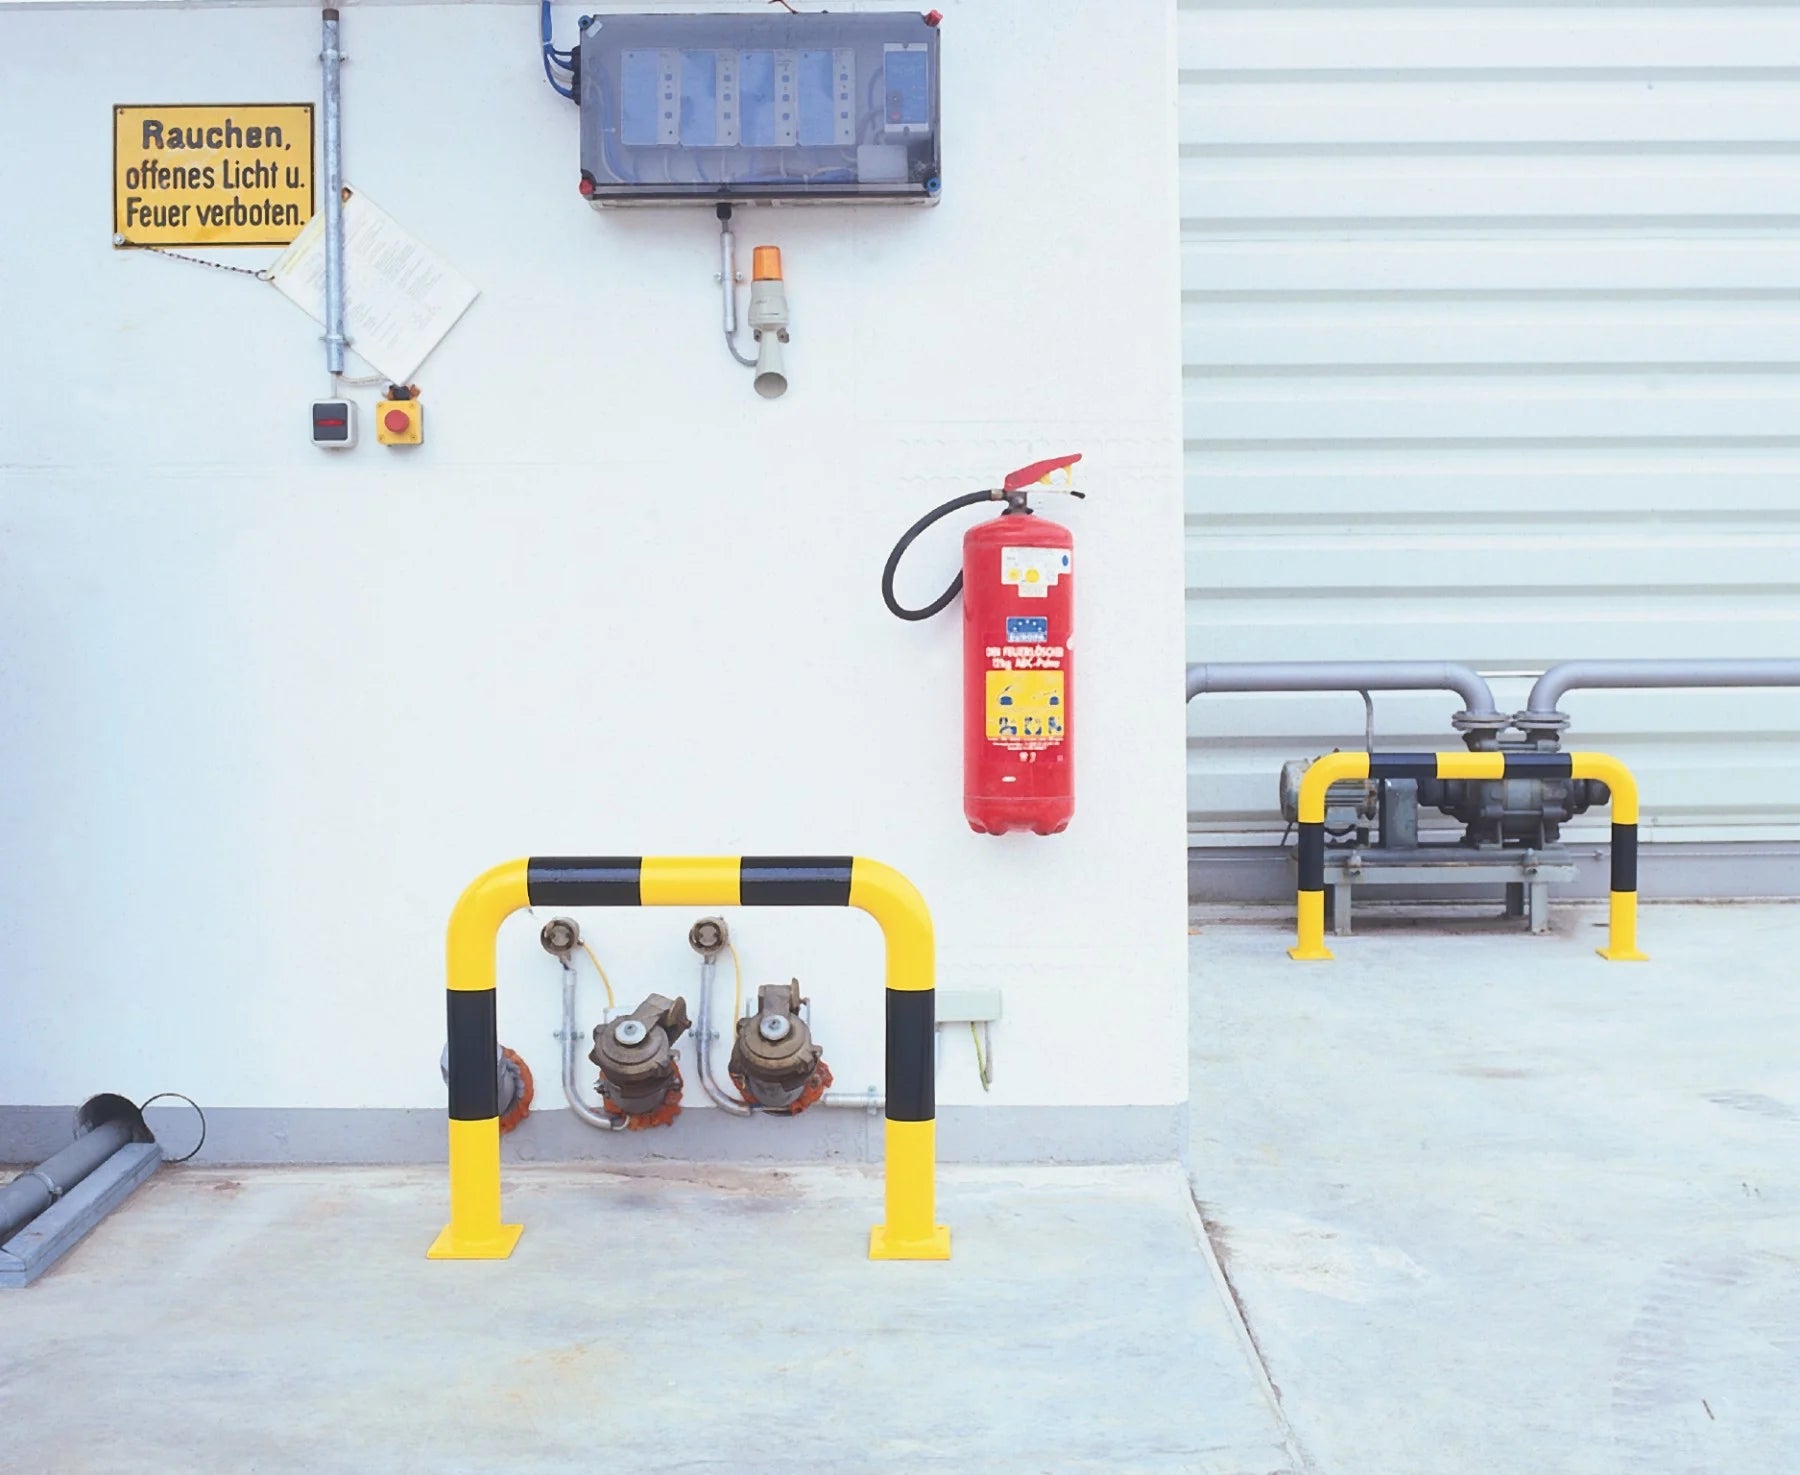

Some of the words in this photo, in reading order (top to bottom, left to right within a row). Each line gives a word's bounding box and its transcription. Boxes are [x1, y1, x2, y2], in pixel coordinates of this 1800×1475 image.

[142, 118, 291, 151] Rauchen,
[126, 159, 215, 190] offenes
[223, 158, 278, 189] Licht
[286, 166, 305, 189] u.
[126, 197, 191, 228] Feuer
[196, 195, 305, 227] verboten.
